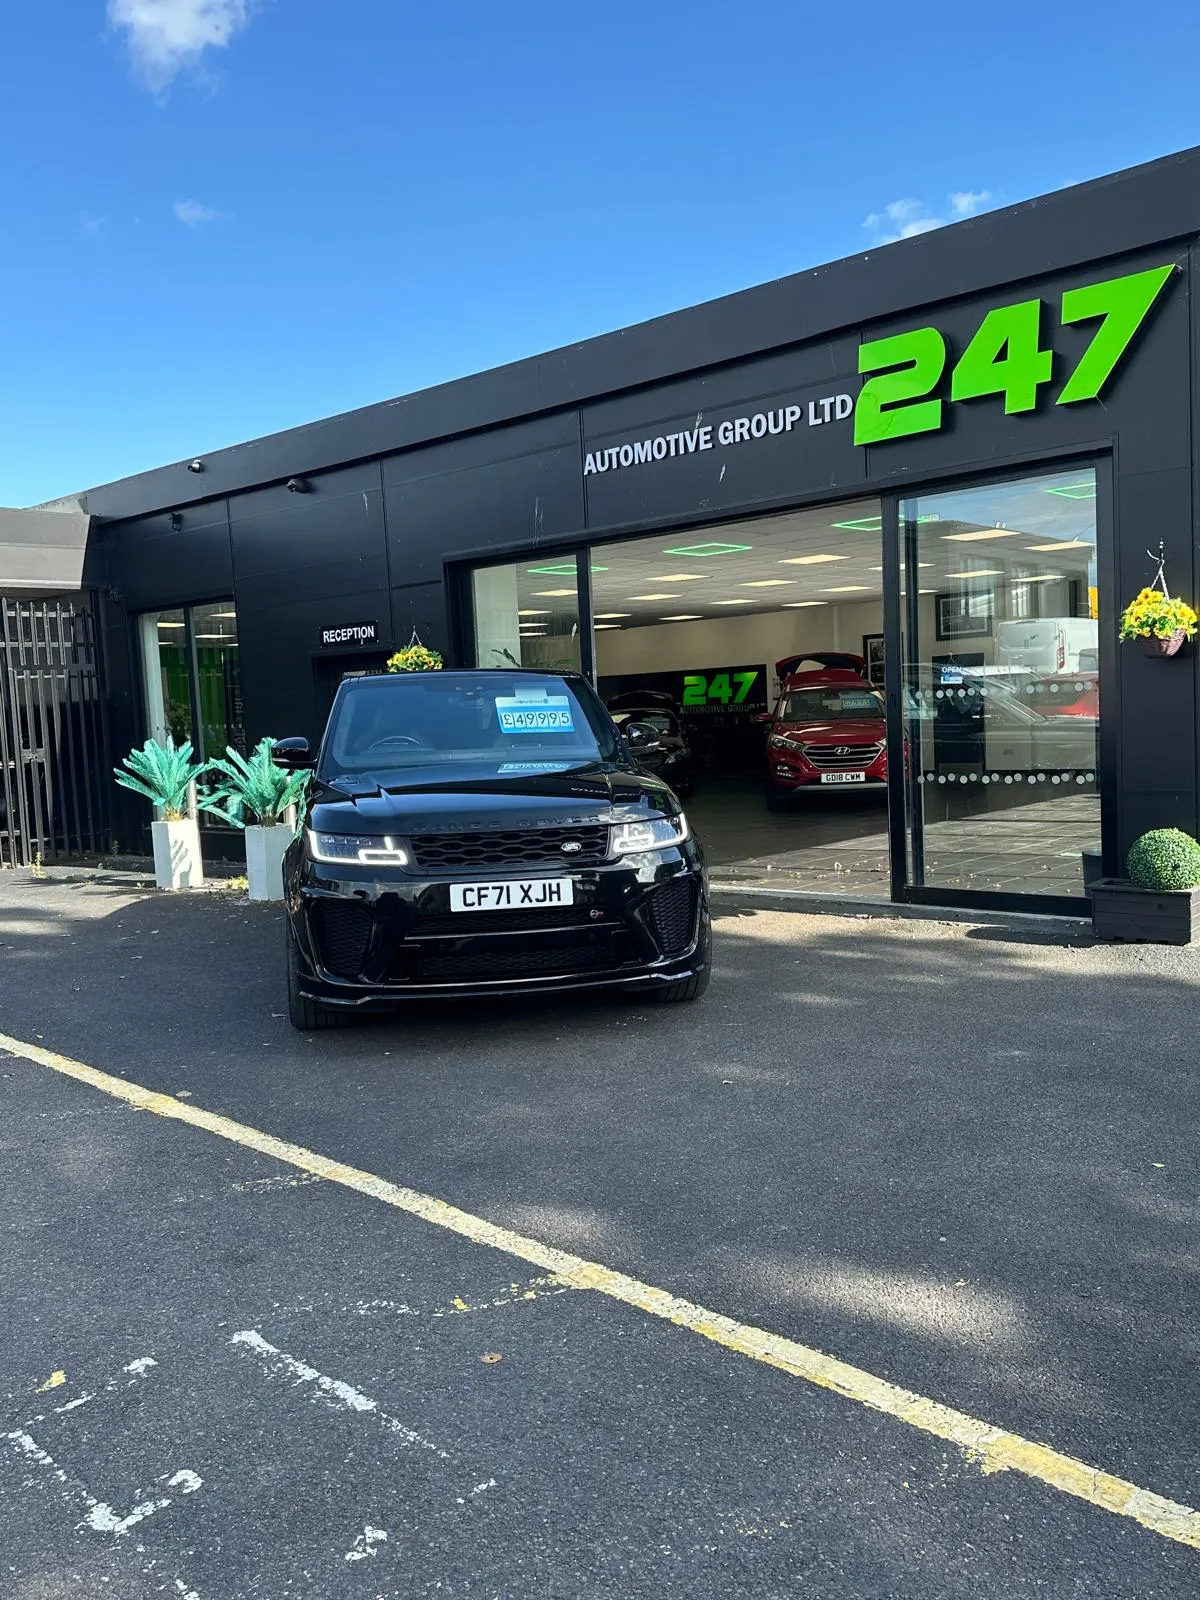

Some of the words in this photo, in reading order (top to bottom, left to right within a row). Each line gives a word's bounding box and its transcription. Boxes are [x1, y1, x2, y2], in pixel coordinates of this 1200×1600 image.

[854, 263, 1176, 446] 247
[583, 426, 713, 476] AUTOMOTIVE
[718, 405, 801, 446] GROUP
[808, 393, 853, 427] LTD
[323, 625, 375, 643] RECEPTION
[683, 671, 759, 706] 247
[503, 712, 570, 726] £49995
[680, 704, 727, 715] AUTOMOTIVE
[462, 884, 511, 907] CF71
[519, 882, 562, 904] XJH
